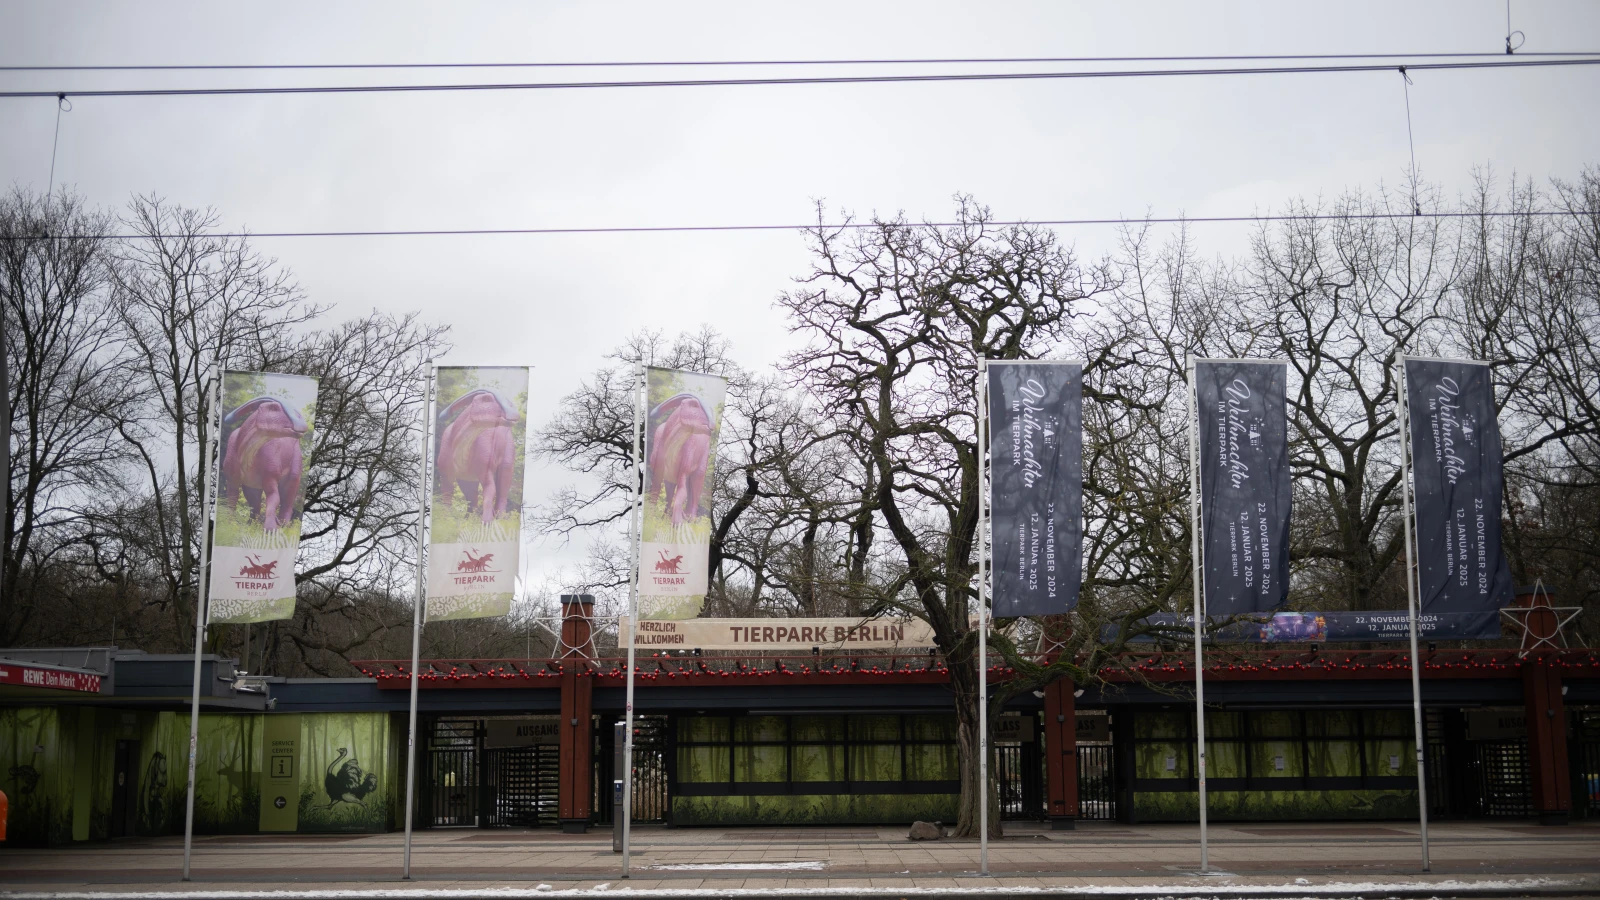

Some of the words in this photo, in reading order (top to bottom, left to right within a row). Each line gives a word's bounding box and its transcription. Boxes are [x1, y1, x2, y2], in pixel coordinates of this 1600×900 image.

[1012, 400, 1019, 411] IM
[1218, 401, 1226, 412] IM
[1428, 398, 1436, 410] IM
[1020, 379, 1045, 488] Weihnachten
[1218, 416, 1227, 466] TIERPARK
[1226, 379, 1250, 489] Weihnachten
[1430, 413, 1442, 463] TIERPARK
[1436, 376, 1466, 484] Weihnachten
[1257, 502, 1266, 515] 22.
[1456, 507, 1465, 522] 12.
[1474, 498, 1483, 512] 22.
[1031, 512, 1039, 525] 12.
[1240, 511, 1249, 524] 12.
[1031, 527, 1039, 565] JANUAR
[1047, 518, 1055, 571] NOVEMBER
[1229, 522, 1237, 551] TIERPARK
[1241, 525, 1252, 562] JANUAR
[1259, 517, 1270, 570] NOVEMBER
[1457, 523, 1468, 561] JANUAR
[1475, 514, 1486, 568] NOVEMBER
[1231, 553, 1239, 577] BERLIN
[1459, 564, 1468, 586] 2025
[454, 575, 496, 585] TIERPARK
[653, 577, 686, 585] TIERPARK
[1029, 568, 1038, 590] 2025
[1047, 576, 1056, 597] 2024
[1244, 565, 1253, 588] 2025
[1261, 573, 1270, 595] 2024
[1478, 572, 1487, 594] 2024
[640, 621, 676, 632] HERZLICH
[1355, 616, 1368, 624] 22.
[729, 626, 828, 643] TIERPARK
[834, 626, 905, 642] BERLIN
[24, 669, 45, 685] REWE
[46, 672, 59, 685] Dein
[59, 673, 76, 688] Markt
[516, 724, 558, 736] AUSGANG
